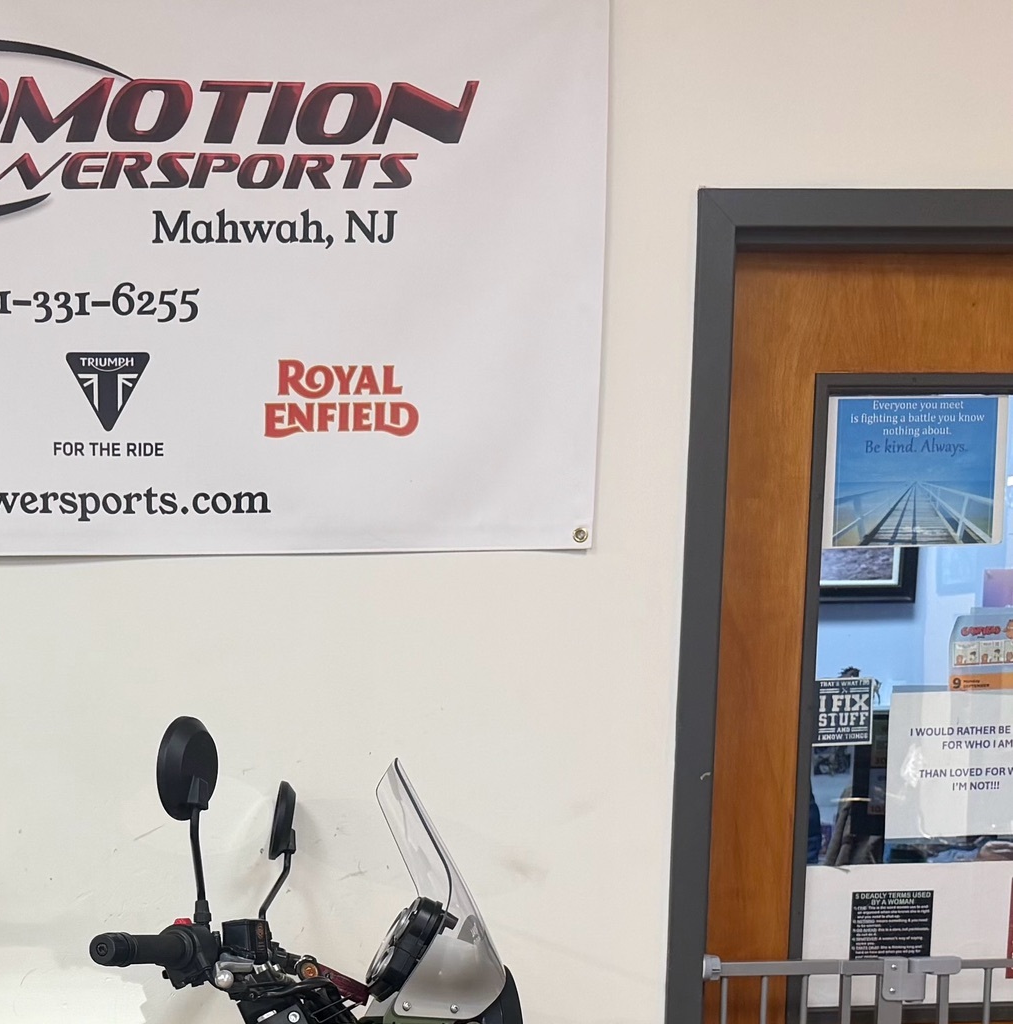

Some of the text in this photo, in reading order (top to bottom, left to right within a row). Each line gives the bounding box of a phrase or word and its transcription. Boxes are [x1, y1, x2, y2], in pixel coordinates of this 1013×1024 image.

[152, 209, 398, 250] Mahwah, NJ
[80, 356, 134, 367] TRIUMPH
[277, 359, 403, 400] ROYAL
[872, 400, 964, 412] Everyone you meet
[264, 402, 419, 439] ENFIELD
[850, 412, 985, 425] is fighting a battle you know
[882, 425, 952, 437] nothing about.
[53, 441, 164, 457] FOR THE RIDE
[865, 440, 881, 454] Be
[884, 437, 917, 454] kind.
[952, 677, 961, 688] 9
[819, 693, 869, 712] I FIX
[818, 711, 869, 727] STUFF
[909, 725, 1011, 737] I WOULD RATHER BE
[942, 740, 963, 750] FOR
[965, 739, 990, 749] WHO
[992, 739, 996, 748] I
[919, 768, 947, 779] THAN
[949, 767, 983, 778] LOVED
[985, 766, 1006, 777] FOR
[952, 781, 1000, 792] I'M NOT!!!
[860, 892, 887, 900] DEADLY
[888, 891, 911, 899] TERMS
